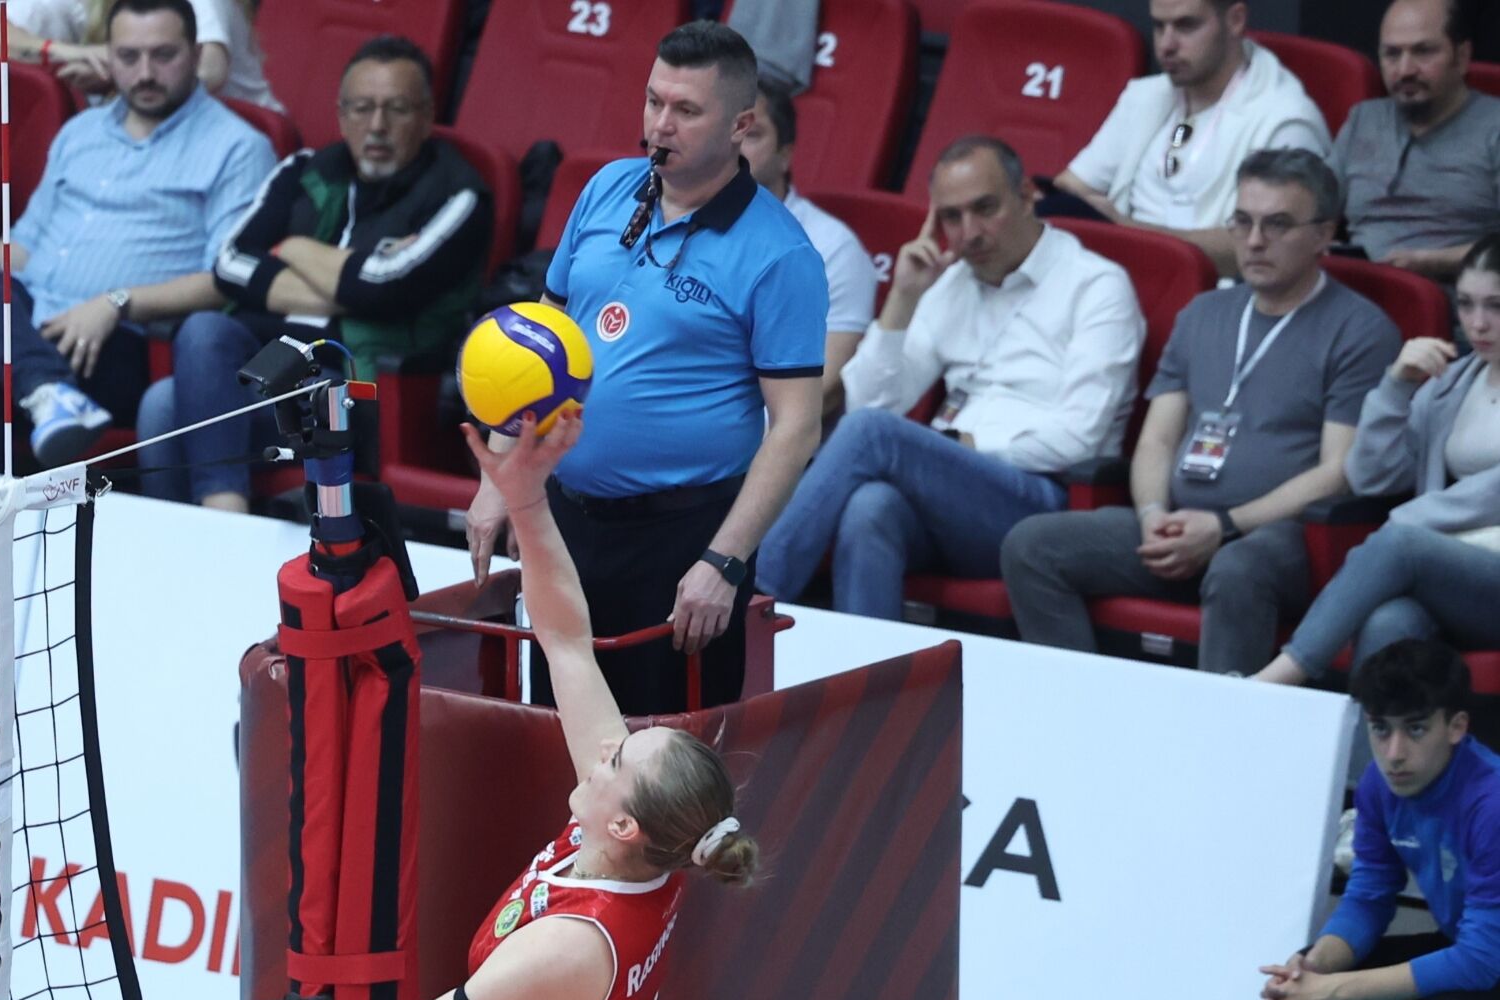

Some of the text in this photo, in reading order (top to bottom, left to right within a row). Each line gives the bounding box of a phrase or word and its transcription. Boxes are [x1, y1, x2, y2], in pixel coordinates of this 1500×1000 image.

[567, 0, 612, 37] 23
[1021, 61, 1065, 99] 21
[21, 856, 241, 977] KADI
